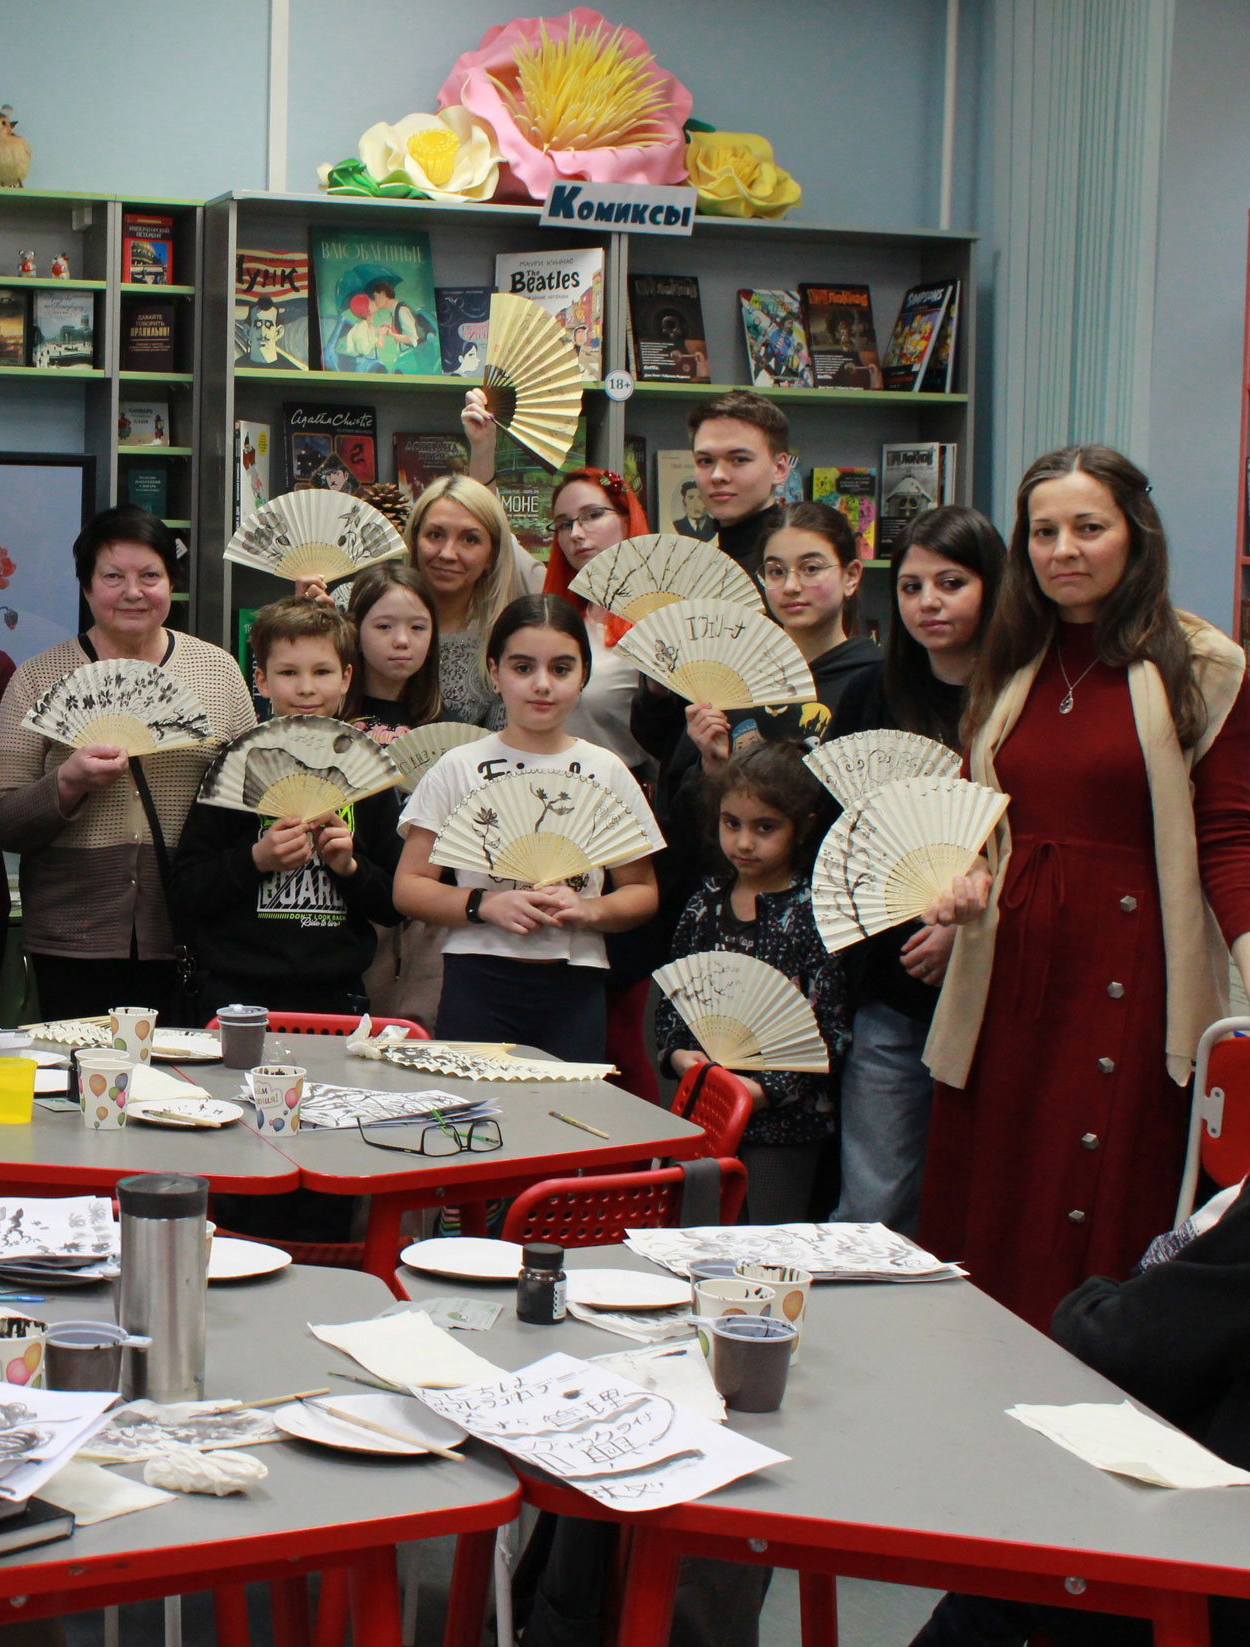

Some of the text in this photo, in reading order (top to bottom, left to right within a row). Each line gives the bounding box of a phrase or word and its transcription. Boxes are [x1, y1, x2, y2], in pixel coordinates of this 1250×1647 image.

[548, 184, 692, 227] Комиксы
[510, 270, 580, 293] Beatles
[130, 327, 170, 338] ПРАВИЛЬНО!
[610, 378, 631, 389] 18+
[291, 408, 373, 428] Agatha Christie
[502, 495, 539, 513] МОНЕ
[314, 913, 330, 921] LOOK
